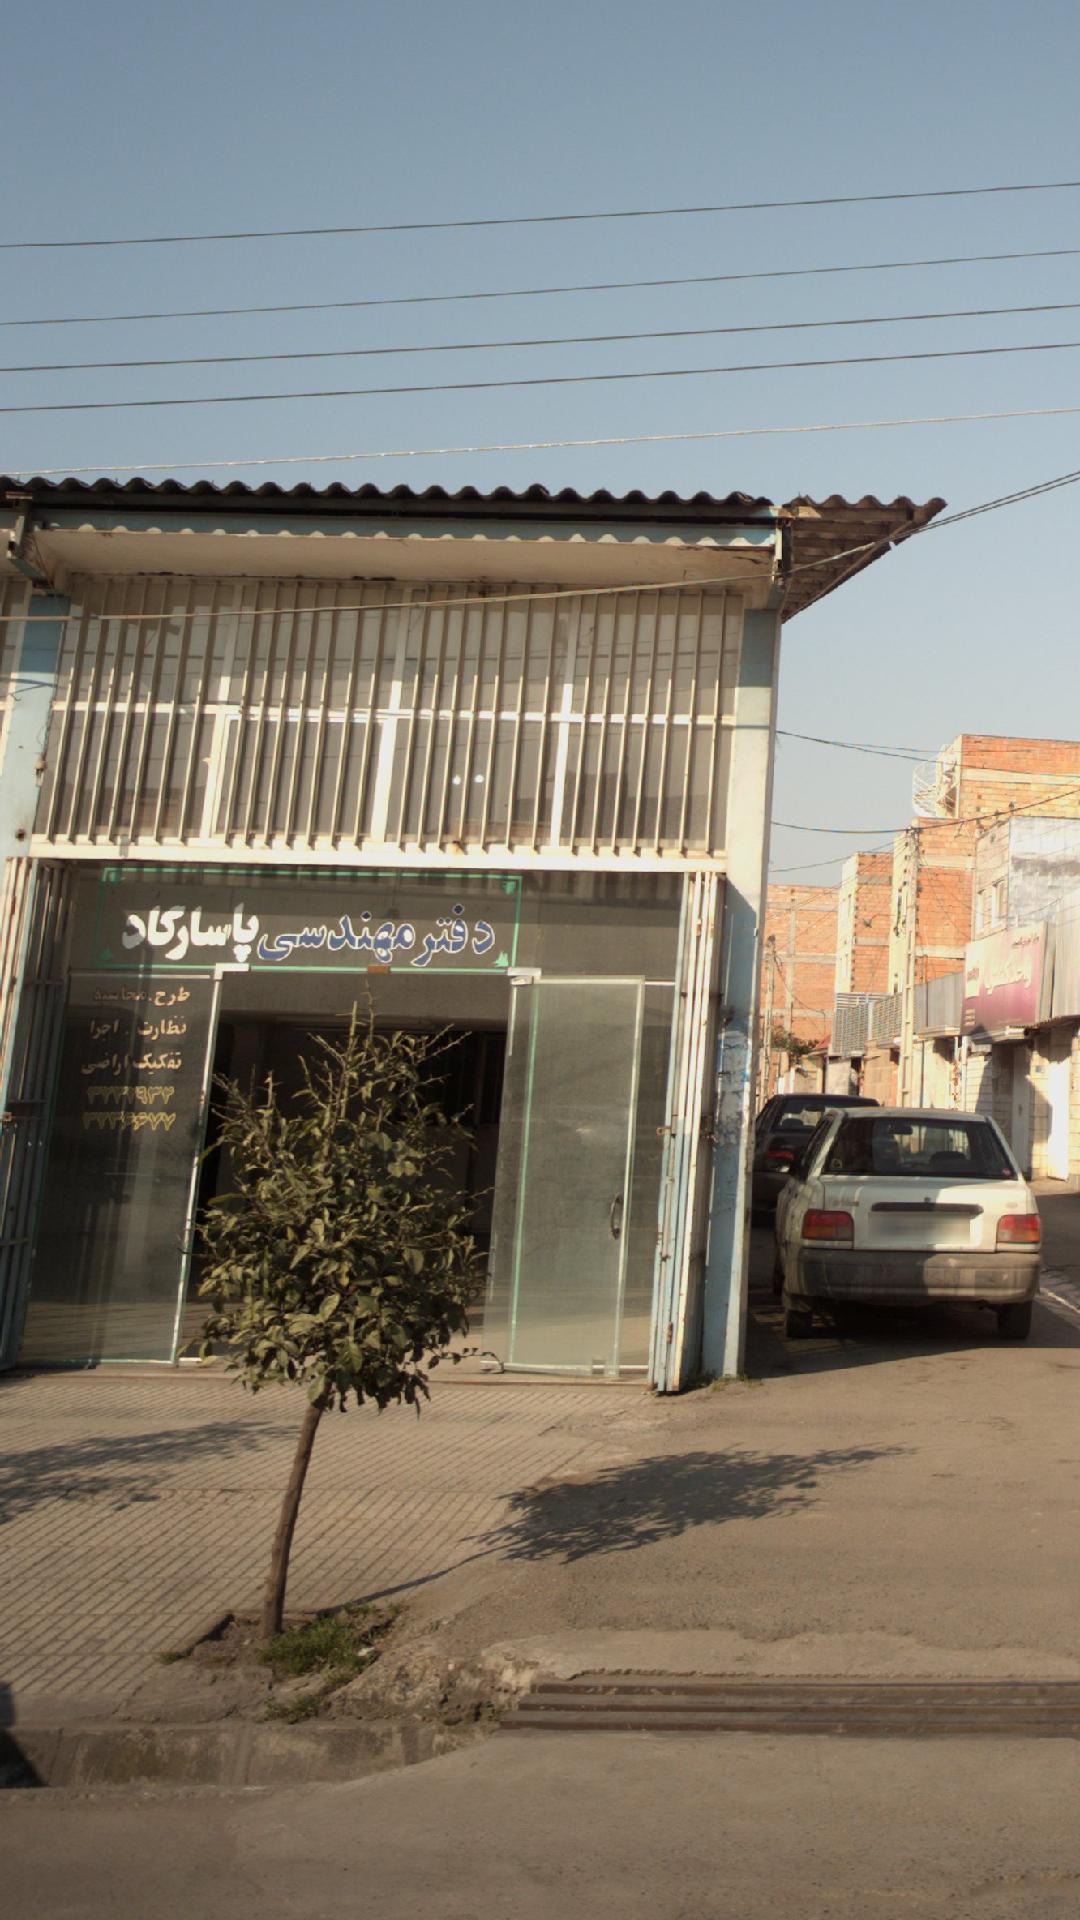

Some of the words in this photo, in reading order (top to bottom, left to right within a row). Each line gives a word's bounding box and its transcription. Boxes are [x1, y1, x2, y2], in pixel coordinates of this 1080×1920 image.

[121, 902, 260, 963] پاسارگاد
[257, 910, 416, 963] مهندسی
[411, 902, 496, 967] دفتر
[90, 1018, 120, 1042] اجرا
[137, 1015, 187, 1040] نظارت
[81, 1052, 130, 1075] اراضی
[132, 1052, 182, 1075] تفکیک
